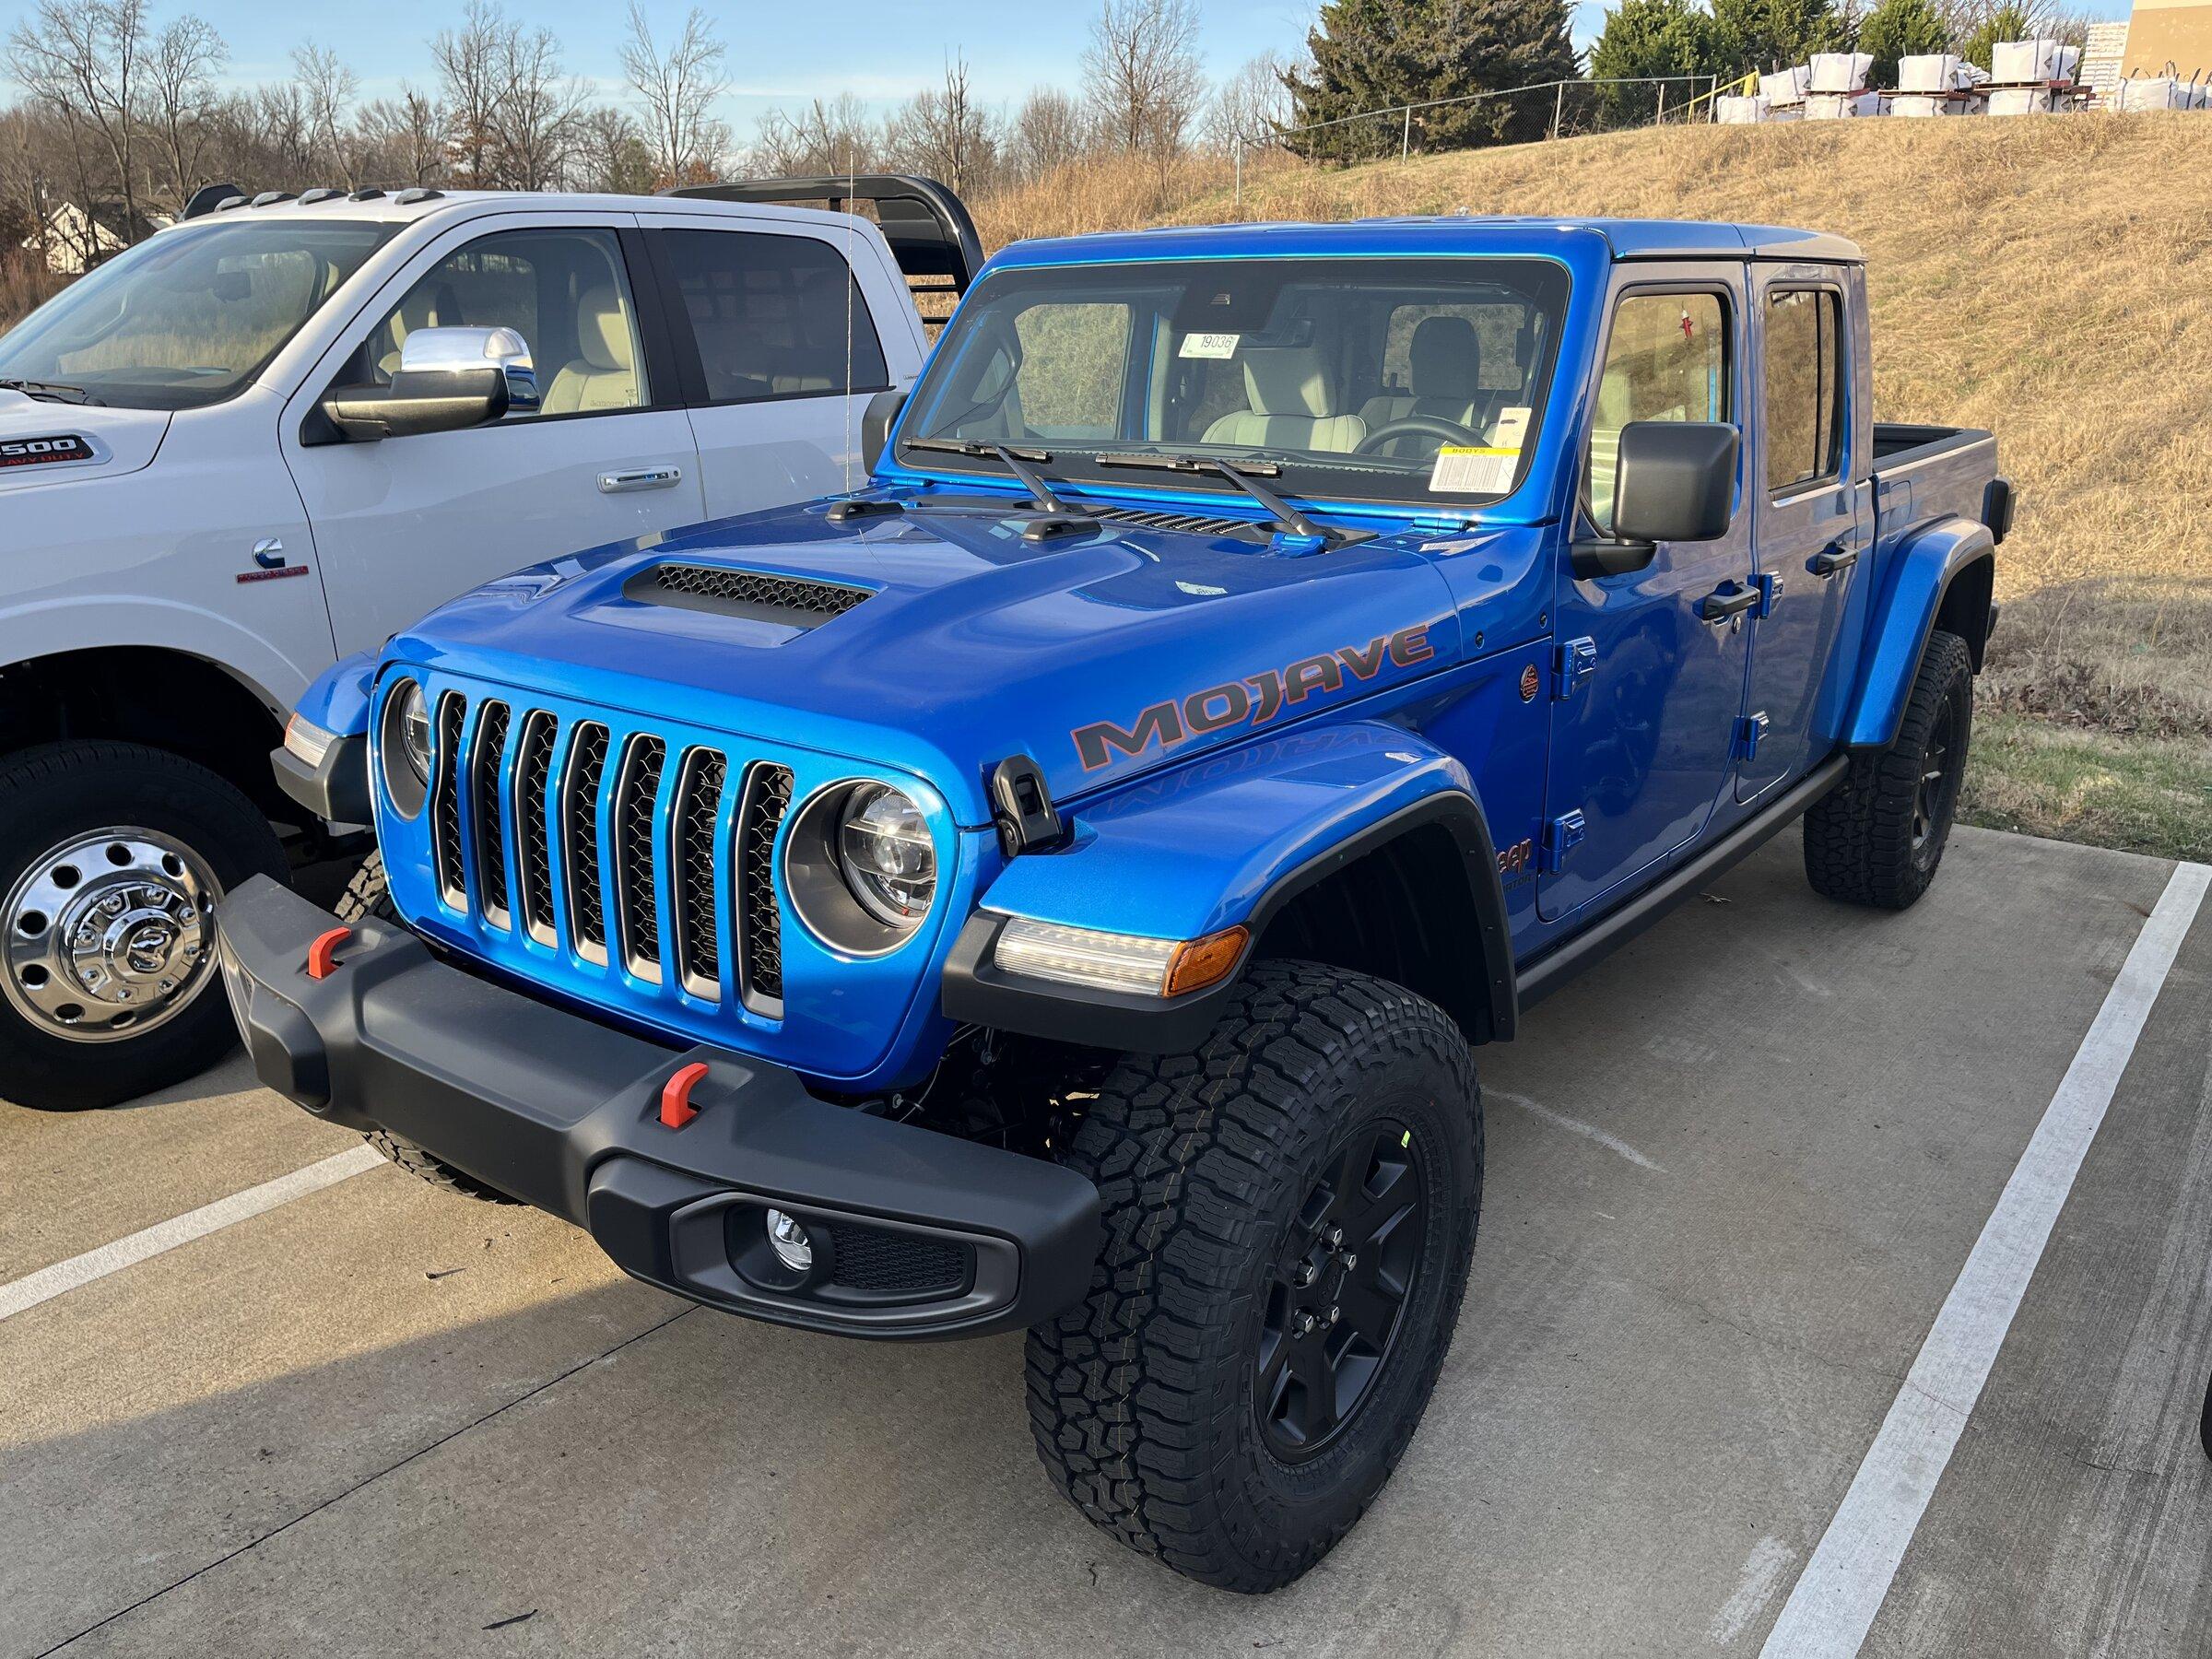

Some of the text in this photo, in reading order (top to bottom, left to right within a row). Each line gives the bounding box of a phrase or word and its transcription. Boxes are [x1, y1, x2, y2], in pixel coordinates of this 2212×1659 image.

[1200, 335, 1233, 348] 19036
[0, 439, 77, 455] 500
[0, 456, 37, 467] EAVY
[1070, 624, 1435, 771] MOJAVE
[1496, 838, 1532, 874] eep
